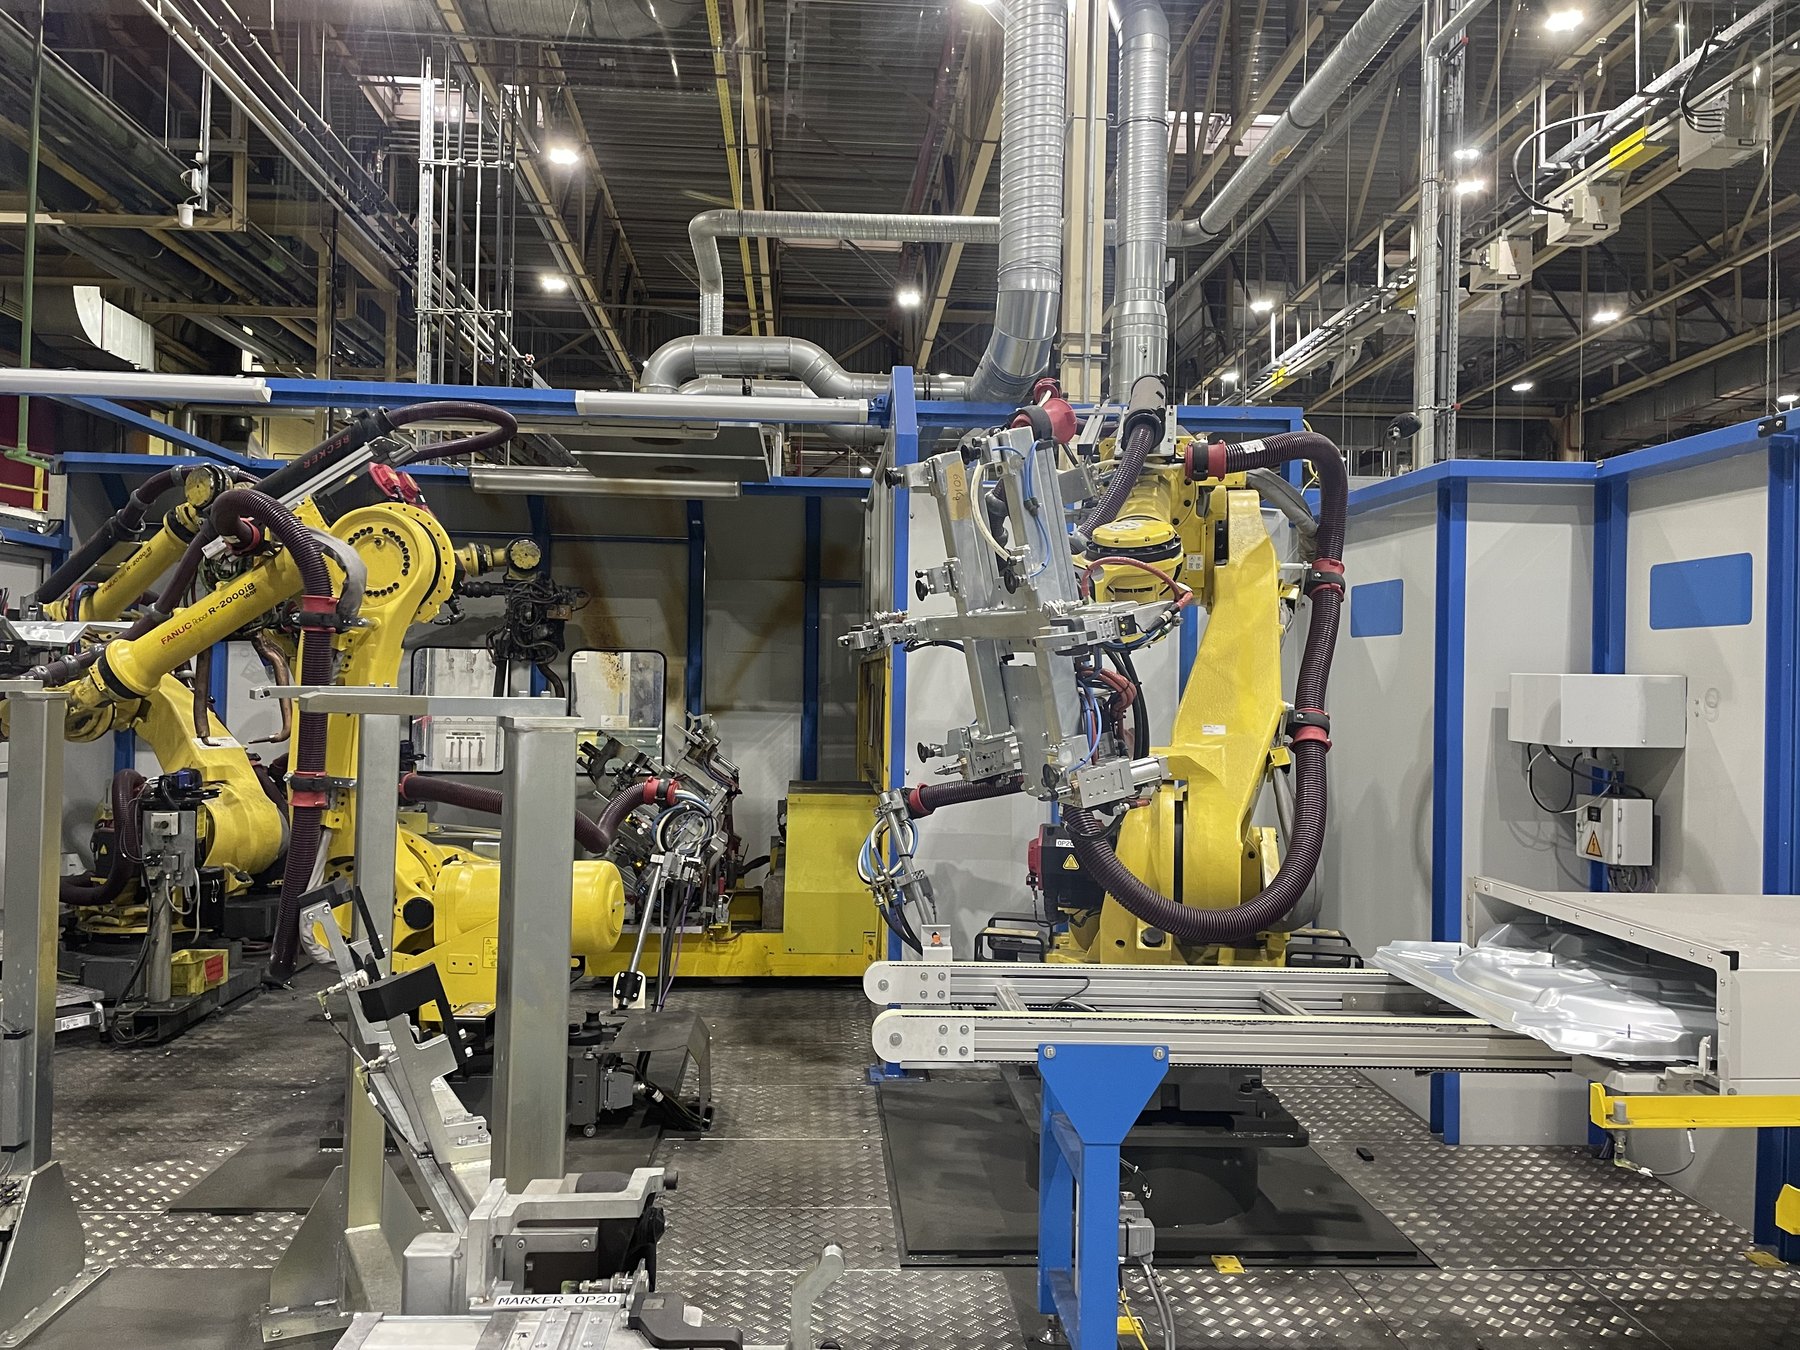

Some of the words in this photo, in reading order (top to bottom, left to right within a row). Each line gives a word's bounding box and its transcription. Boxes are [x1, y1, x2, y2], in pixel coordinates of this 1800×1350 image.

[161, 622, 192, 645] FANUC
[208, 582, 256, 615] R-2000iB
[497, 1295, 564, 1305] MARKER
[574, 1295, 617, 1304] OP20
